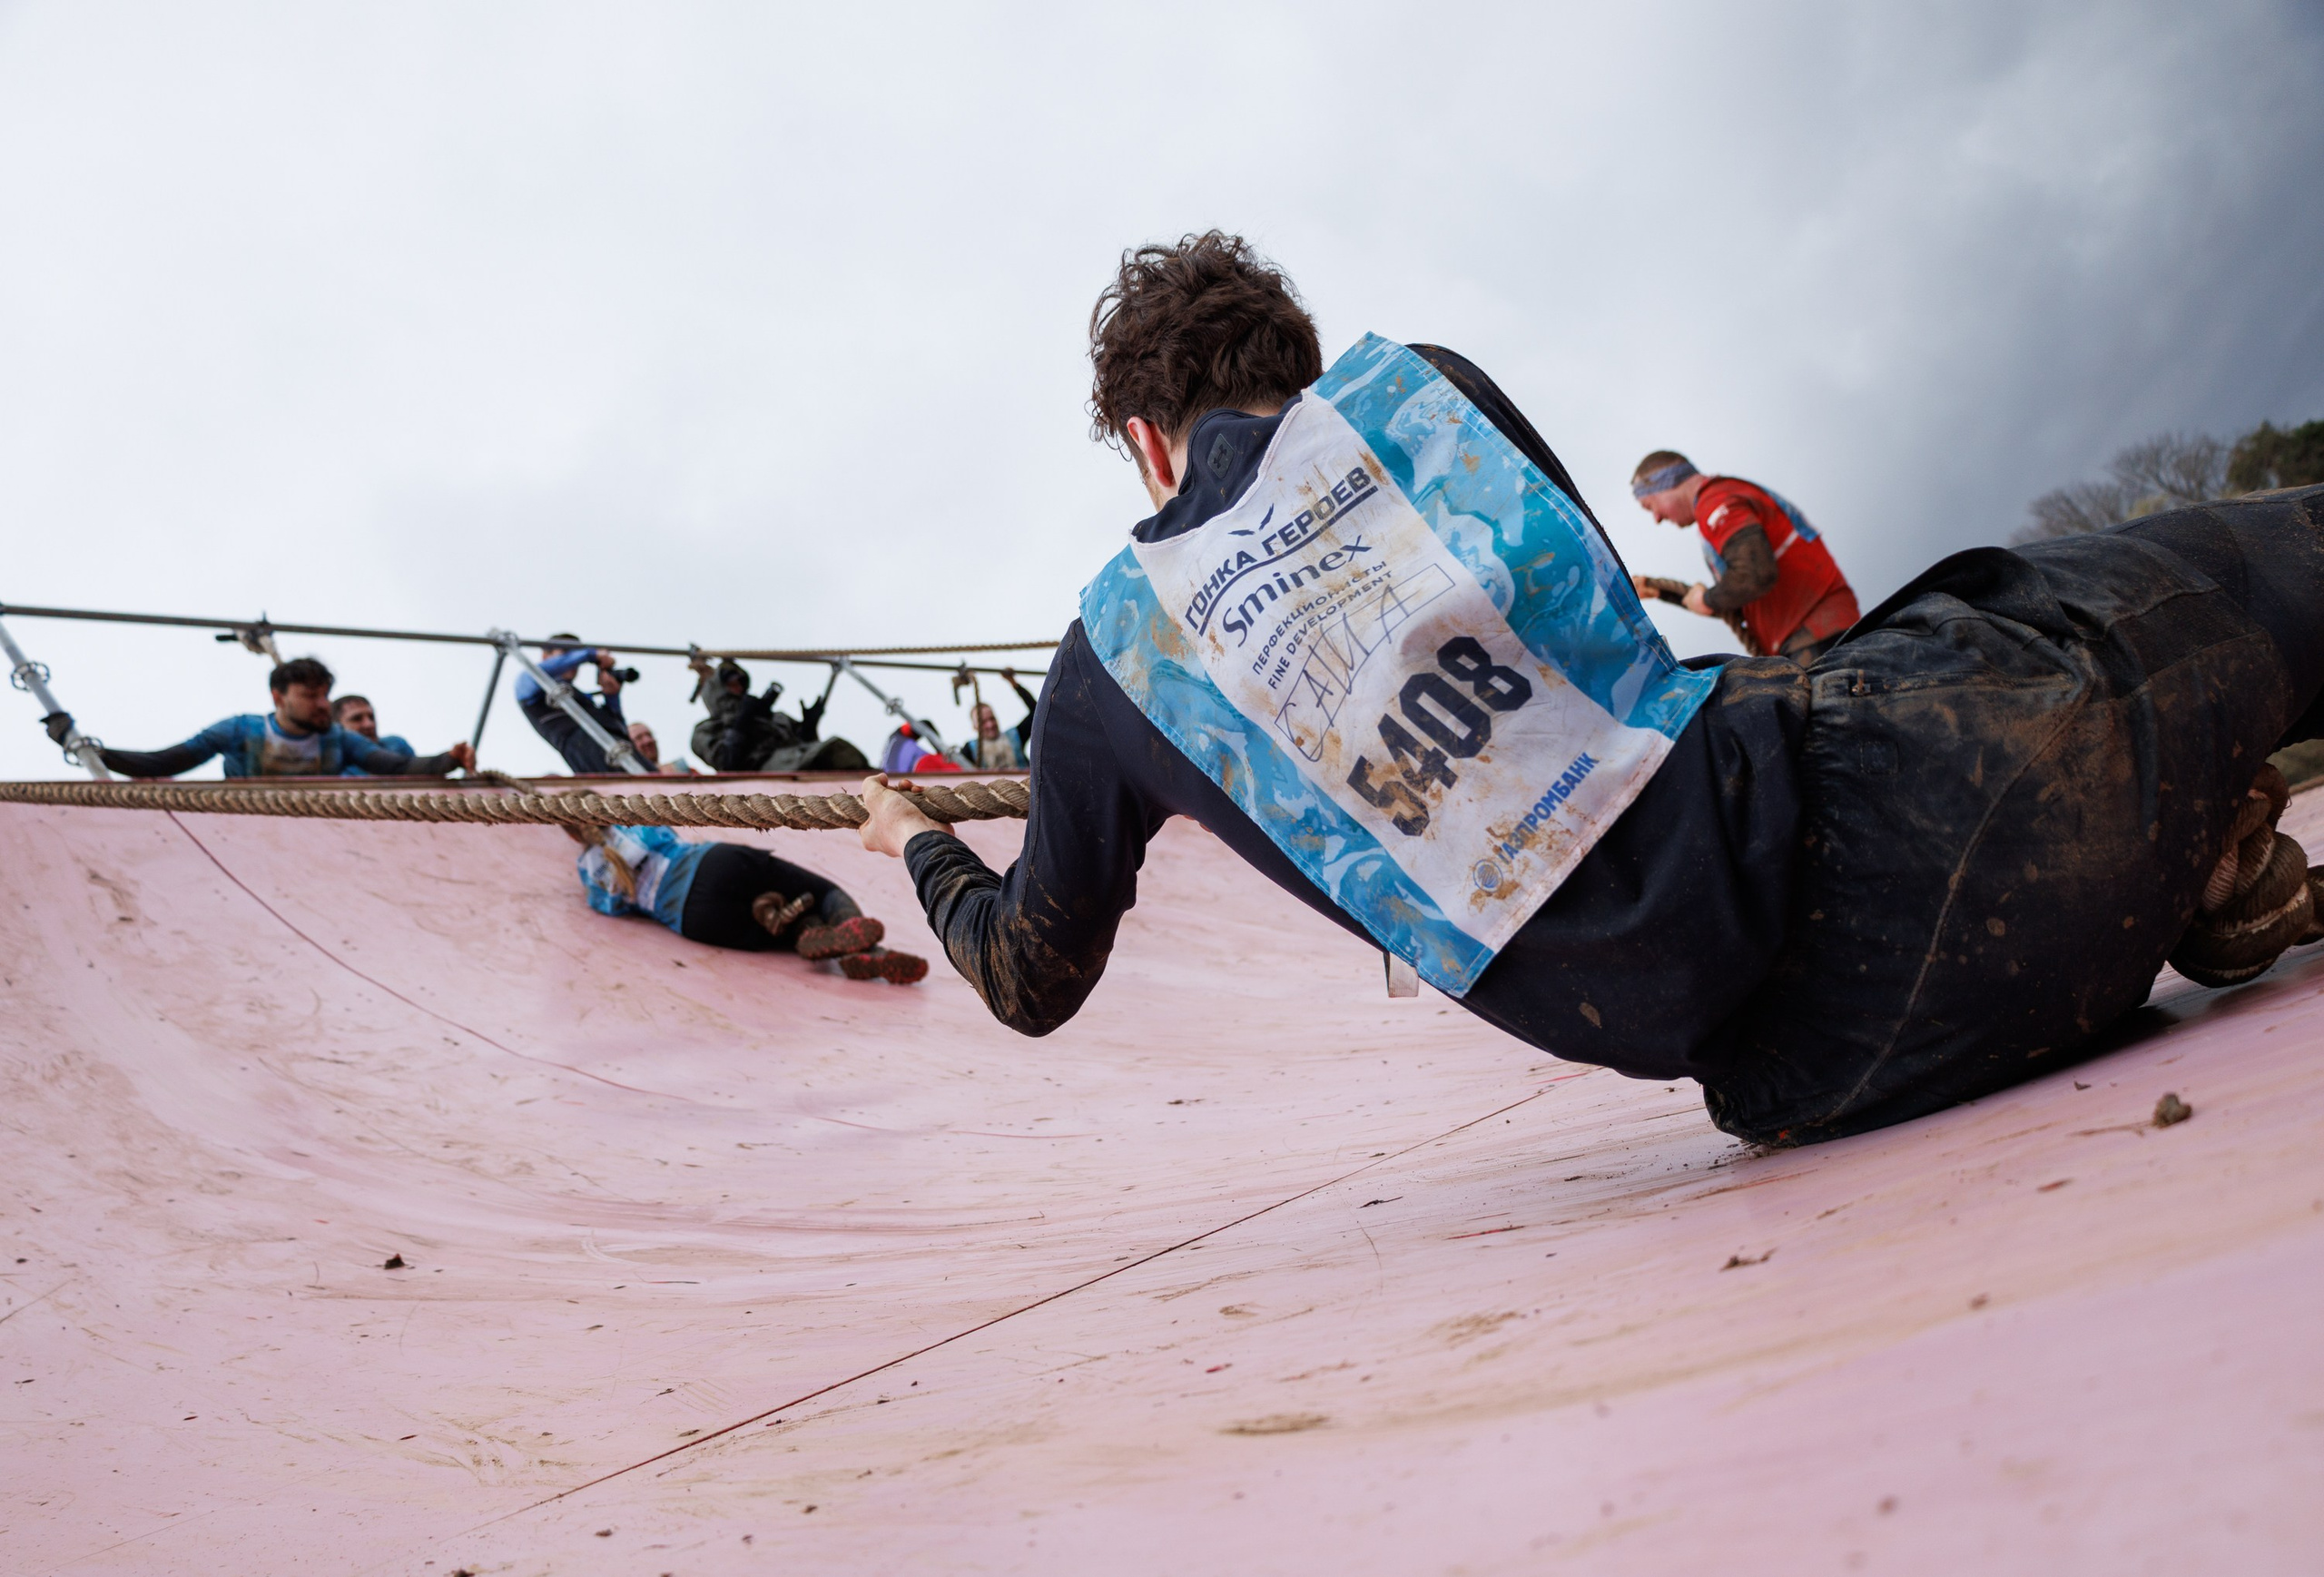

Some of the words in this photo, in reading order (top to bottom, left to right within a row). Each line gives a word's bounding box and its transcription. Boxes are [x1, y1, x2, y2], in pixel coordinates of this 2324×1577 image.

[1185, 550, 1258, 629] ГОНКА
[1261, 466, 1372, 557] ГЕРОЕВ
[1223, 534, 1373, 648] Sminex
[1268, 656, 1291, 690] FINE
[1285, 570, 1393, 655] DEVELOPMENT
[1346, 636, 1533, 837] 5408
